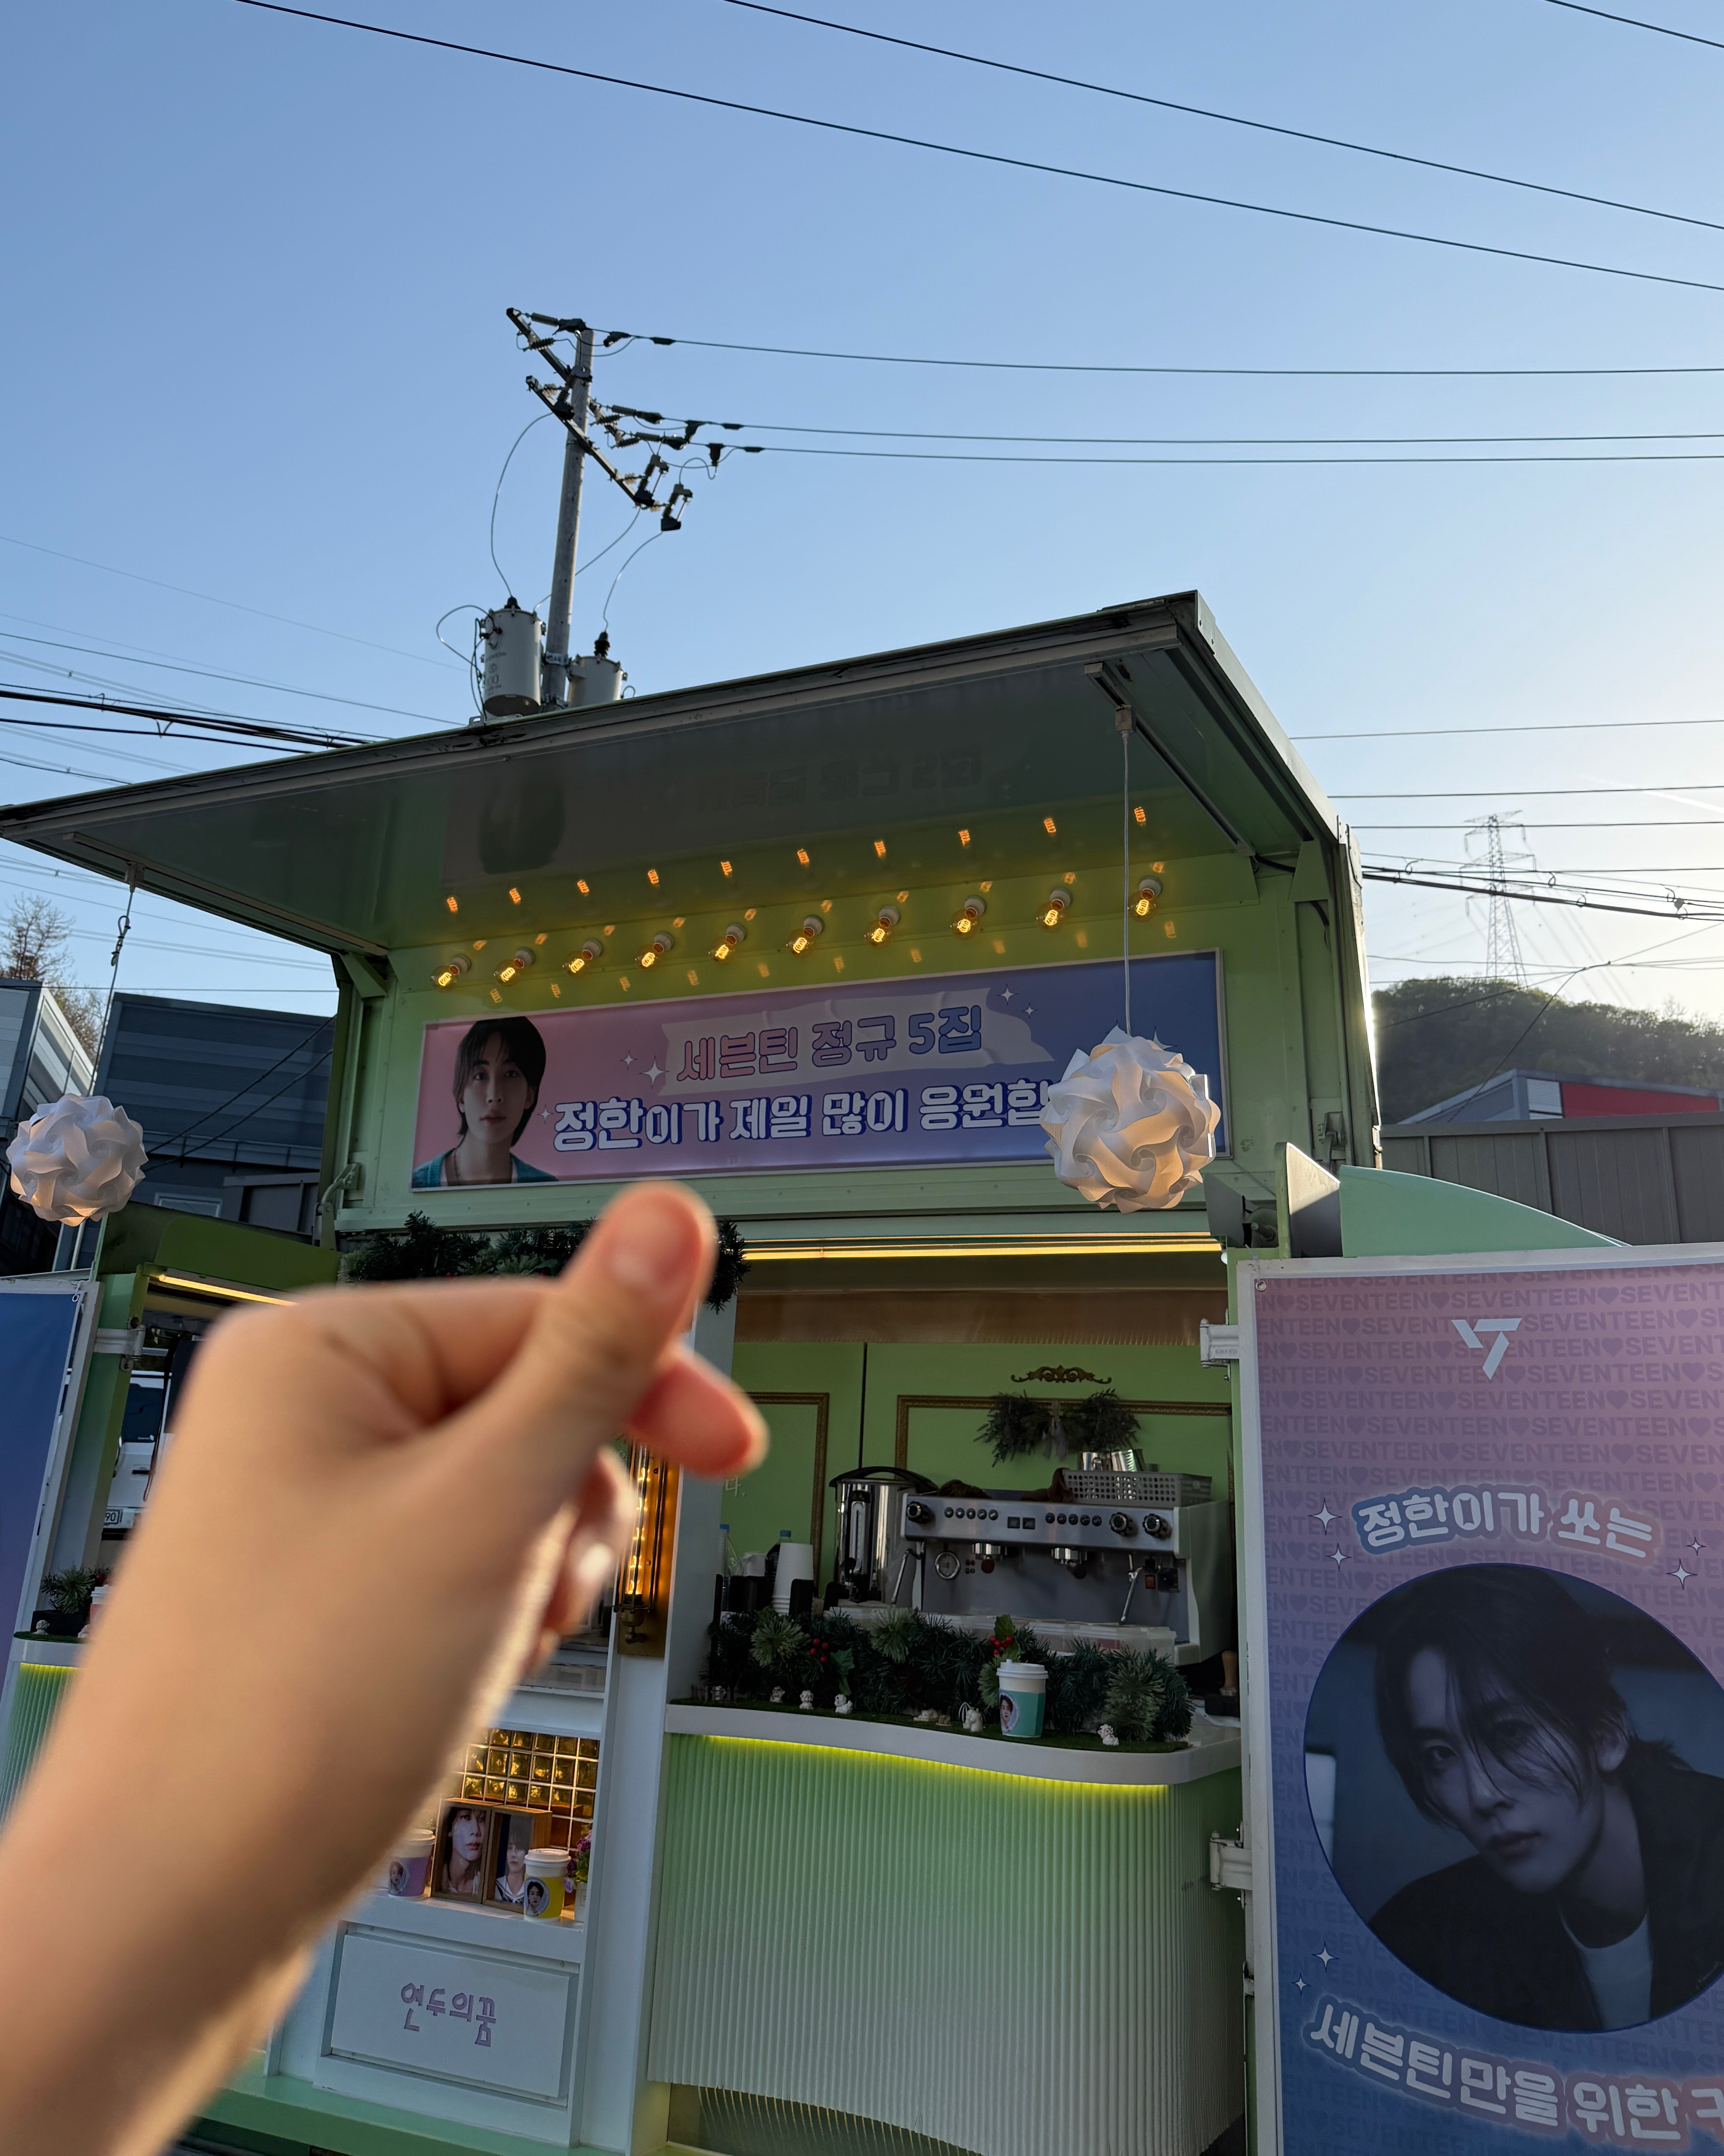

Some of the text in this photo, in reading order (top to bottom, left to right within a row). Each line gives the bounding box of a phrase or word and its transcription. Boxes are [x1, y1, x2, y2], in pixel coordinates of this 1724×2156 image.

[676, 1005, 982, 1082] 세븐틴 정규 5집
[553, 1097, 724, 1152] 정한이가
[729, 1095, 812, 1139] 제일
[821, 1089, 909, 1136] 많이
[1296, 1291, 1429, 1311] SEVENTEEN
[1451, 1286, 1596, 1309] SEVENTEEN
[1362, 1315, 1499, 1334] SEVENT
[1524, 1310, 1674, 1332] SEVENTEEN
[1299, 1341, 1431, 1359] SEVENTEEN
[1527, 1362, 1679, 1383] SEVENTEEN
[1301, 1391, 1434, 1409] SEVENTEEN
[1458, 1390, 1605, 1409] SEVENTEEN
[1630, 1389, 1724, 1410] SEVEN
[1367, 1416, 1507, 1436] SEVENTEEN
[1532, 1417, 1687, 1437] SEVENTEEN
[1303, 1441, 1438, 1460] SEVENTEEN
[1461, 1443, 1610, 1464] SEVENTEEN
[1537, 1470, 1693, 1492] SEVENTEEN
[1358, 1491, 1545, 1547] 정한이가
[401, 1983, 496, 2047] 연두의꿈
[1311, 2004, 1558, 2128] 세븐틴만을
[1574, 2084, 1681, 2141] 위한
